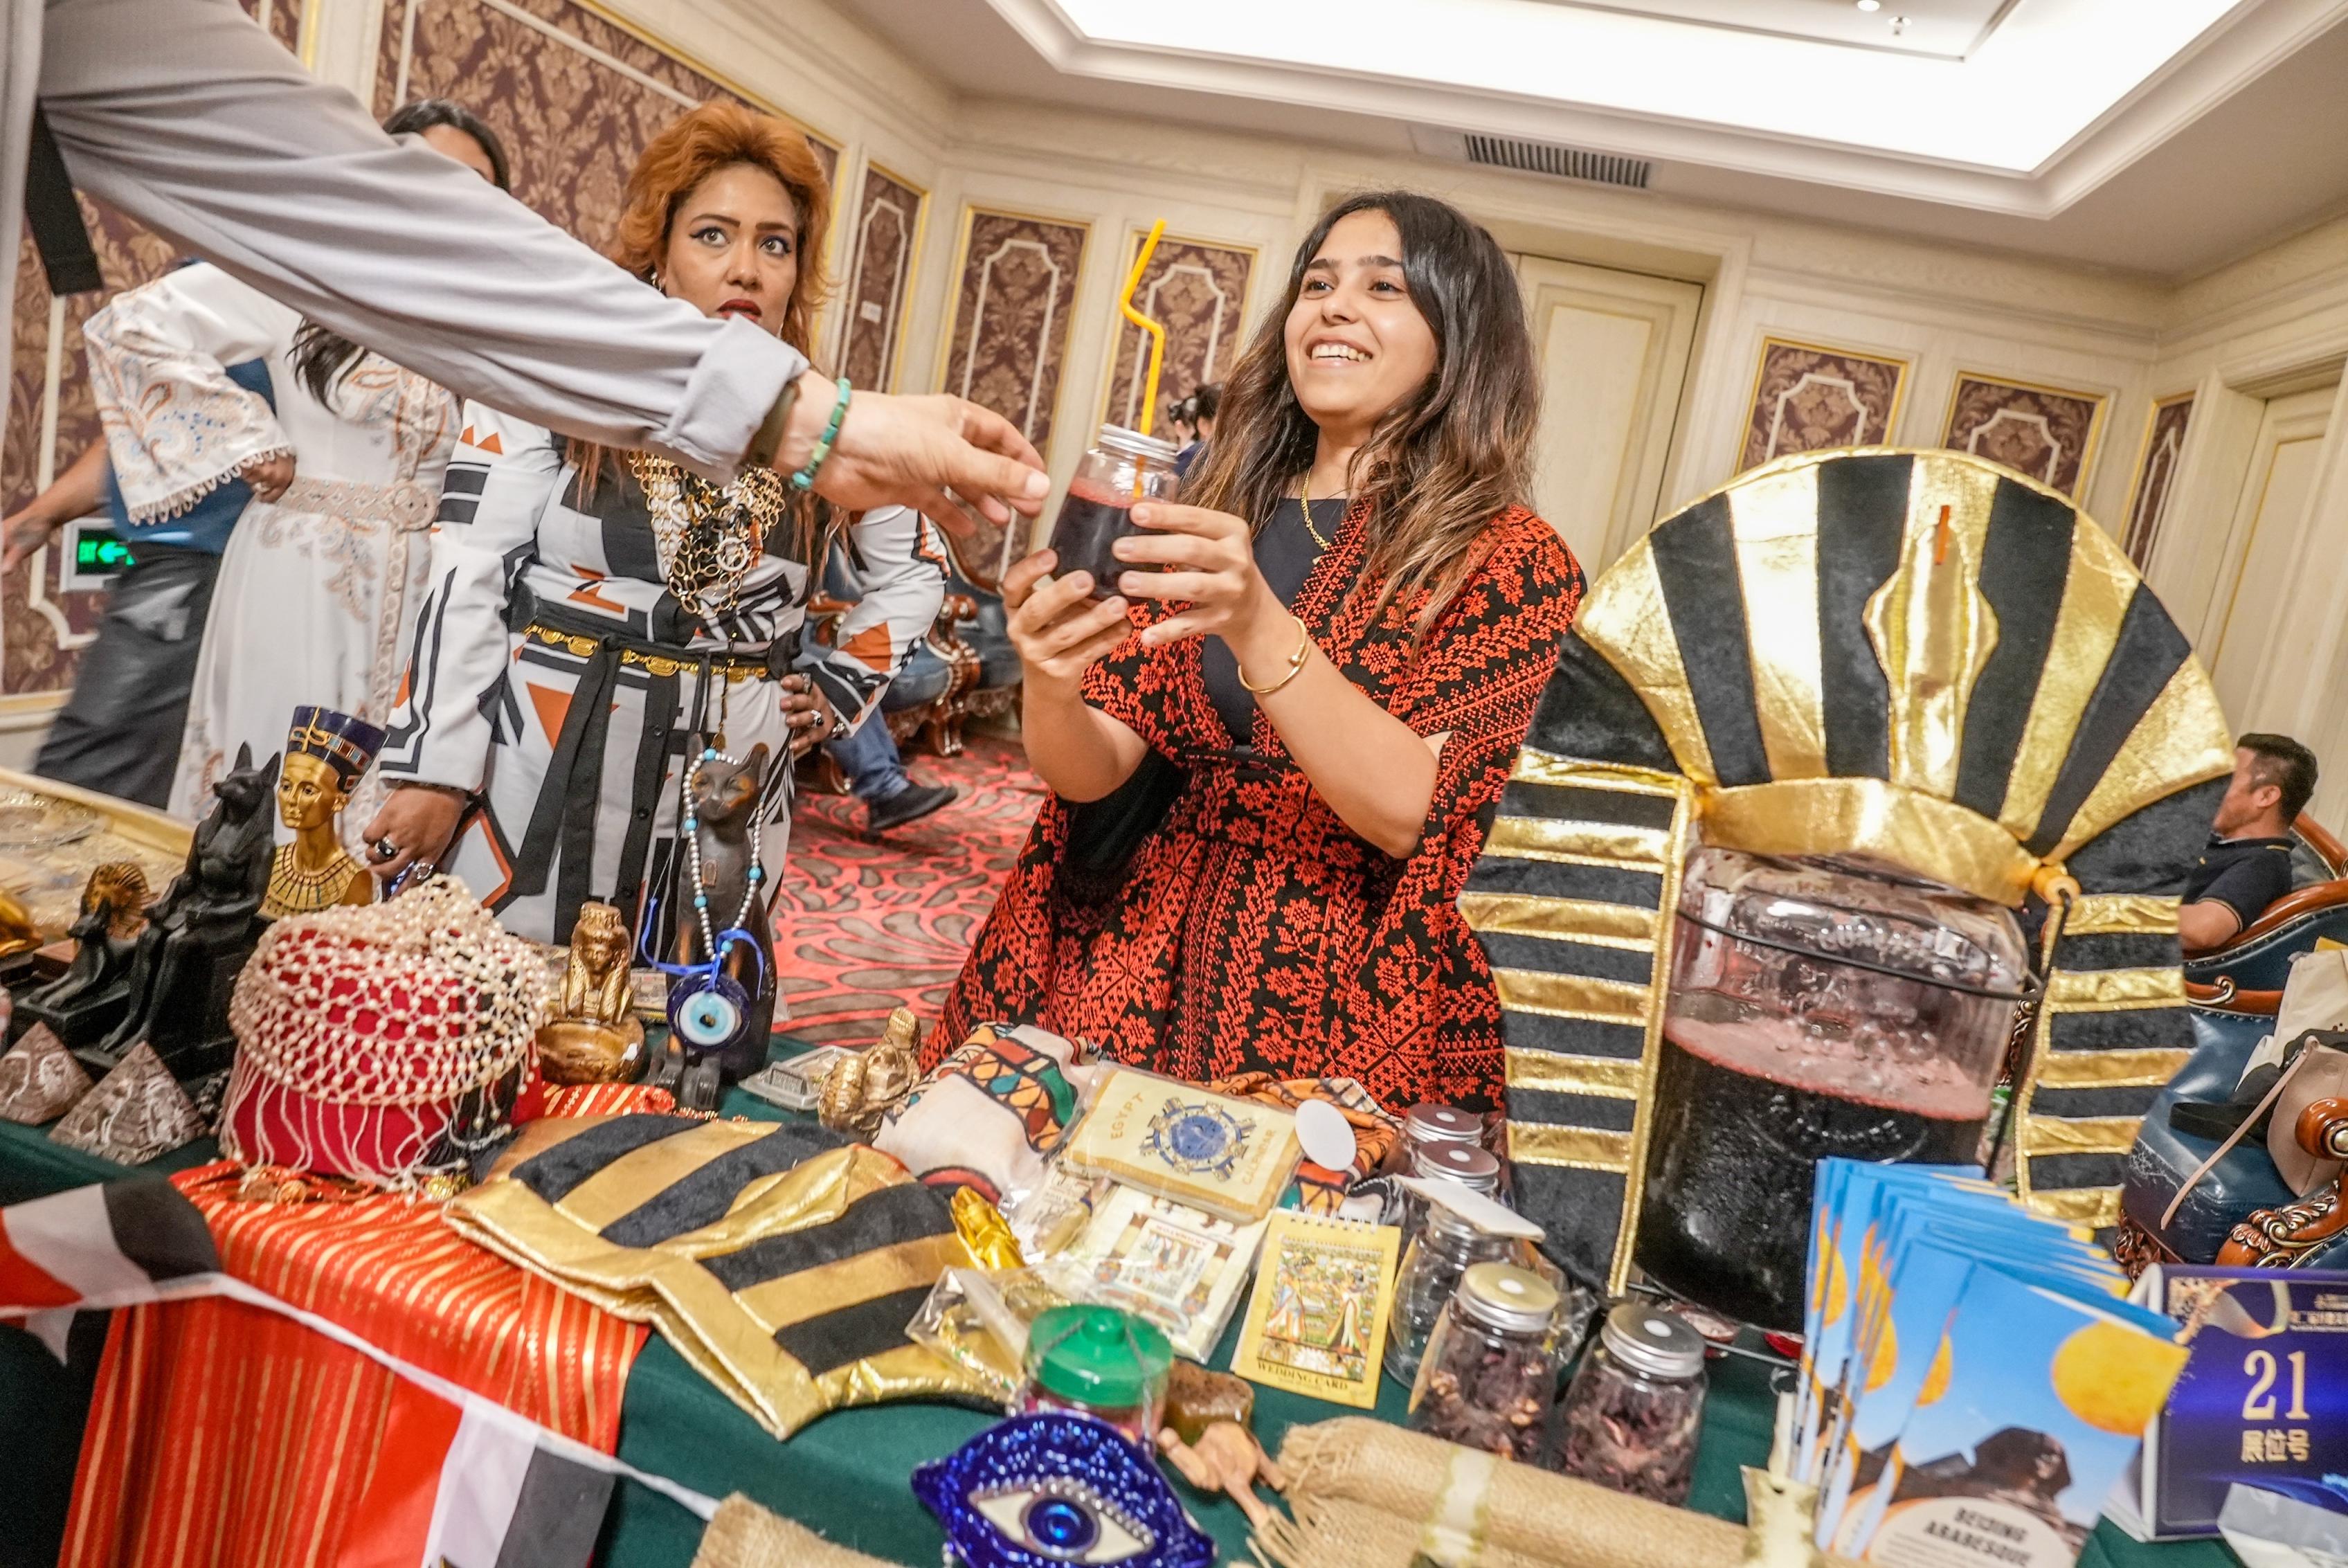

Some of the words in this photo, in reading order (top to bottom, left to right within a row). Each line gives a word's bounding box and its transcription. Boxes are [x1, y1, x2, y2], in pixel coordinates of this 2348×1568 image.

[1110, 1092, 1144, 1140] EGYPT
[1257, 1361, 1312, 1384] WEDDING
[1315, 1376, 1348, 1390] CARD
[2241, 1349, 2311, 1420] 21
[2241, 1428, 2311, 1463] 展位号
[1923, 1520, 2032, 1567] ARABESQUE
